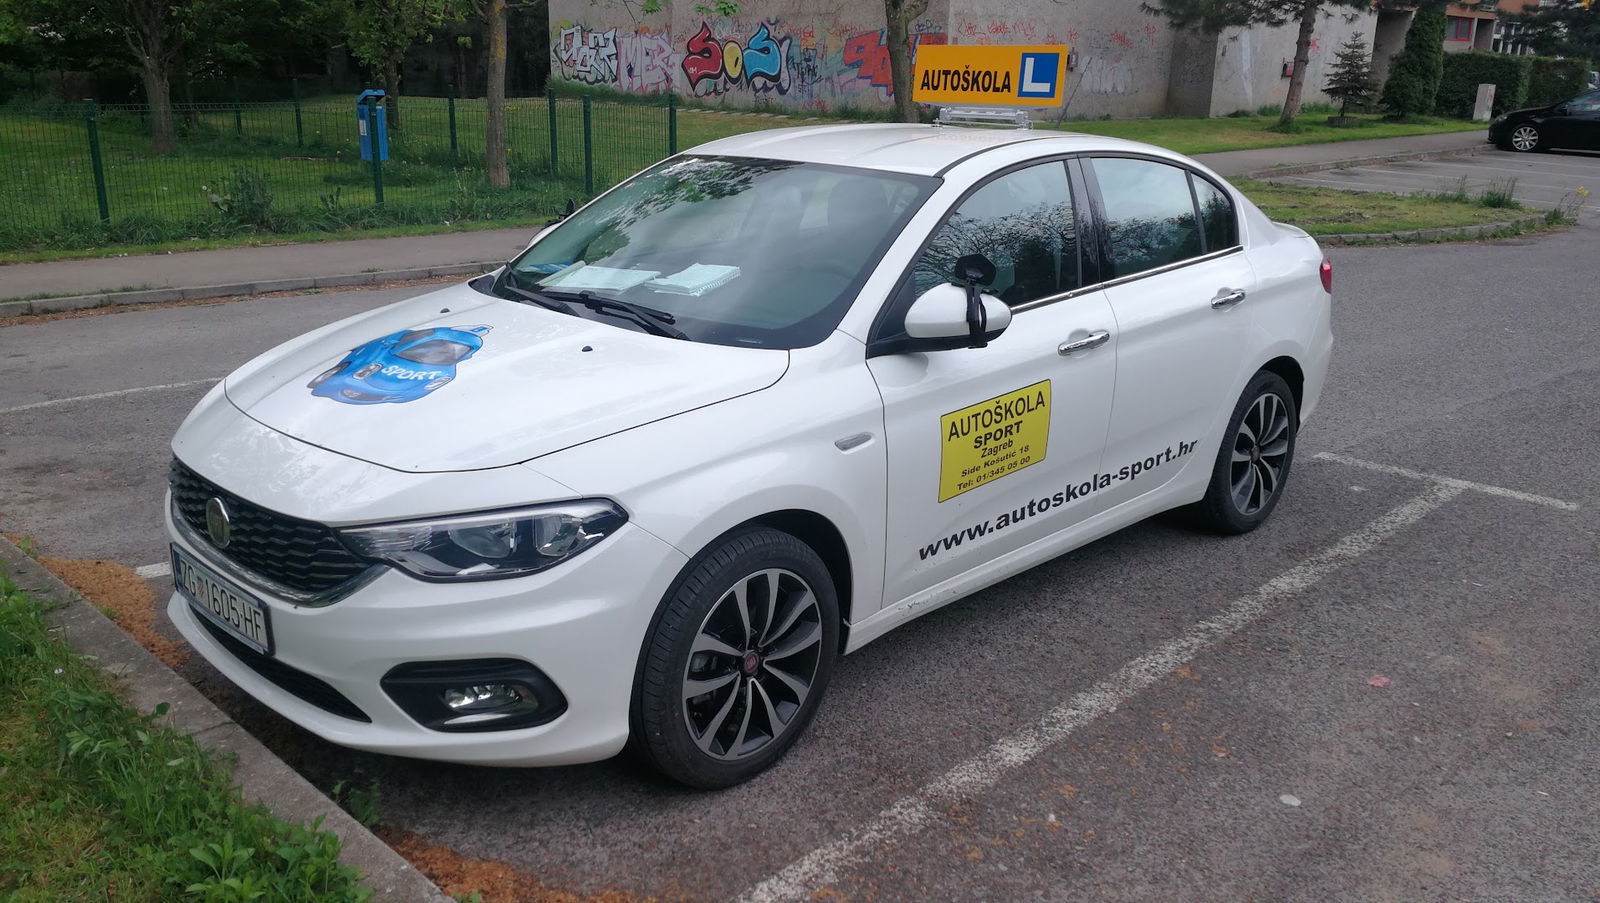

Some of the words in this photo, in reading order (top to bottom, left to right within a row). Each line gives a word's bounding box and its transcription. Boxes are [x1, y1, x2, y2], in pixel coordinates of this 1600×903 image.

[920, 64, 1012, 93] AUTOŠKOLA
[1022, 57, 1051, 93] L
[381, 364, 442, 381] SPORT
[948, 391, 1045, 441] AUTOŠKOLA
[973, 420, 1023, 449] SPORT
[981, 438, 1014, 458] Zagreb
[957, 479, 974, 491] Tel:
[1020, 454, 1031, 466] 00
[961, 465, 981, 477] Side
[919, 439, 1198, 560] www.autoskola-sport.hr
[180, 560, 196, 596] ZG
